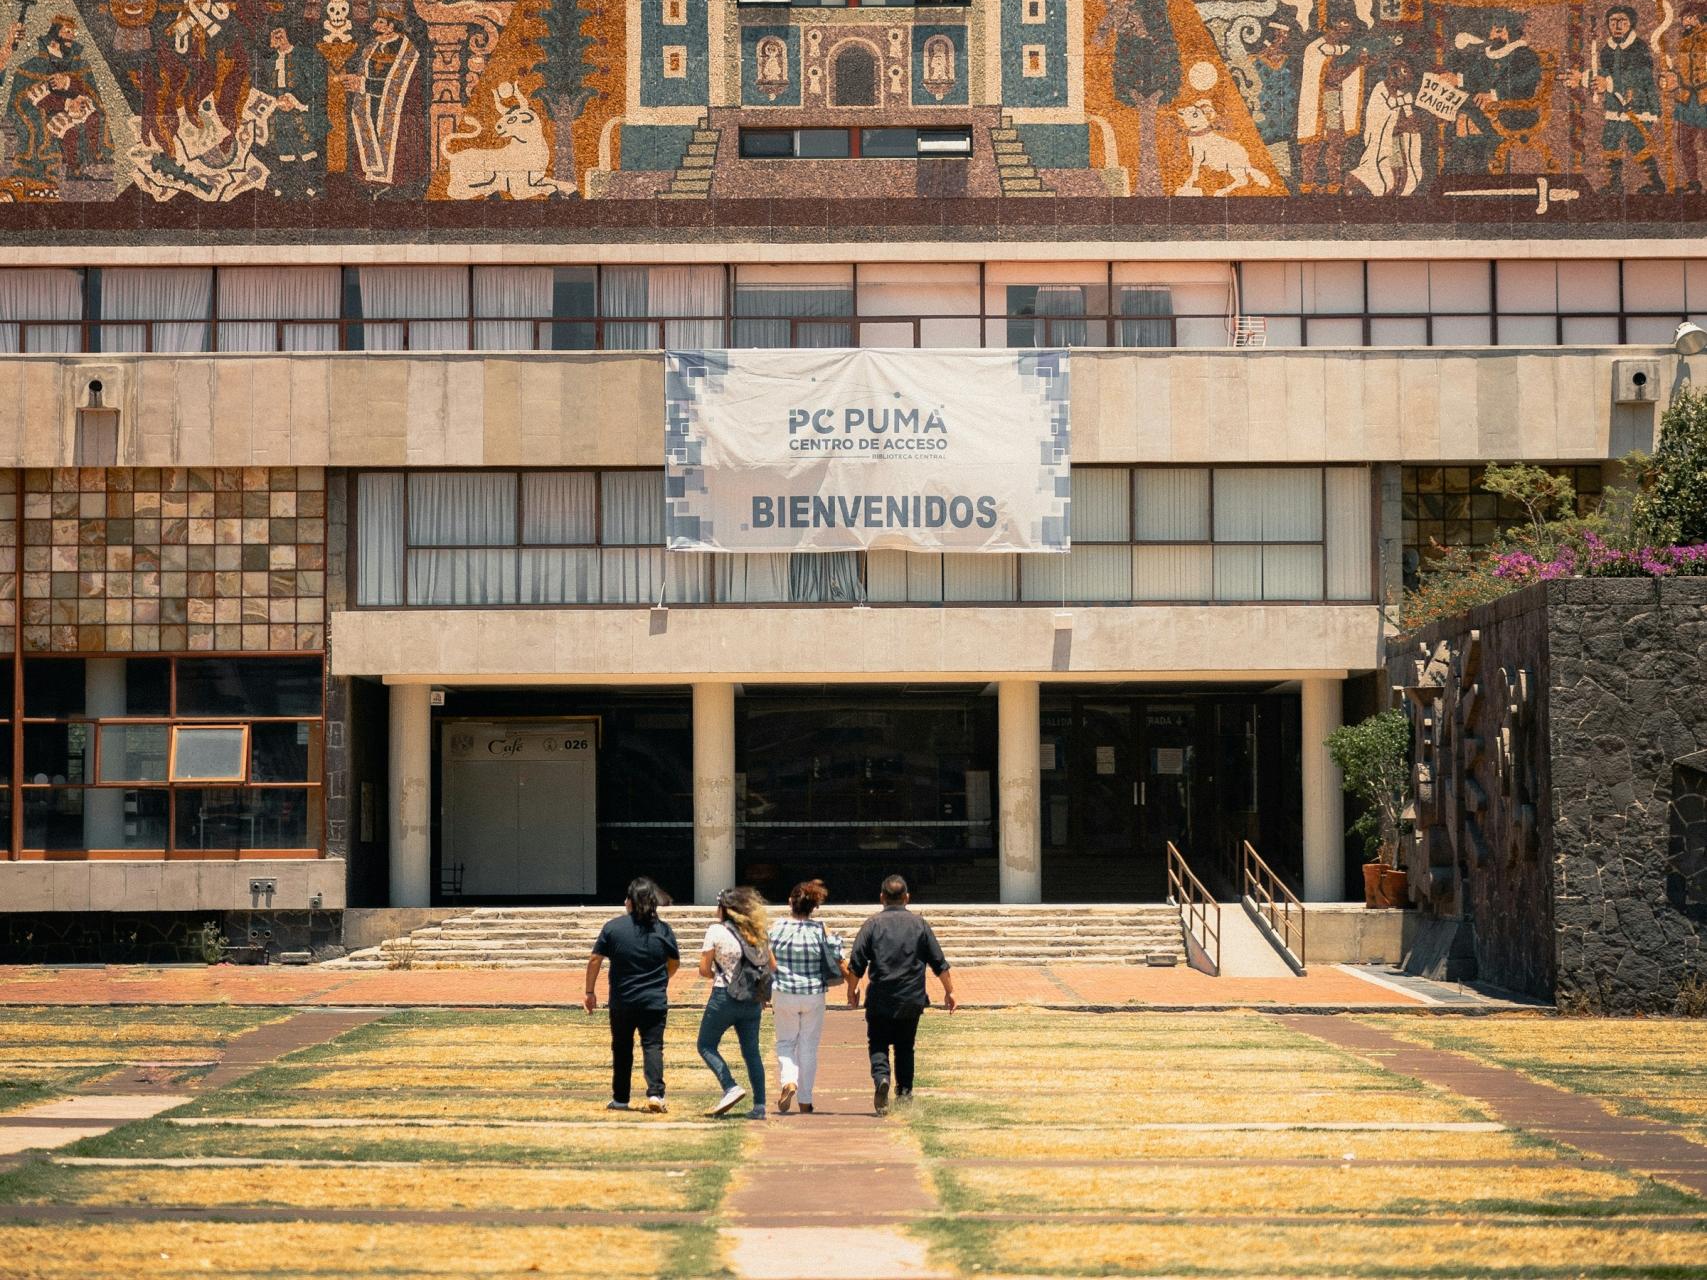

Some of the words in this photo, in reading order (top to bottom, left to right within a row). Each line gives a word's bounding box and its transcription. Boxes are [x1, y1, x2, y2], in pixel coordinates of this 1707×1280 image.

[788, 408, 835, 435] PC
[844, 407, 948, 435] PUMA
[789, 438, 854, 451] CENTRO
[858, 438, 880, 451] DE
[883, 438, 948, 451] ACCESO
[751, 494, 998, 529] BIENVENIDOS
[564, 739, 588, 750] 026
